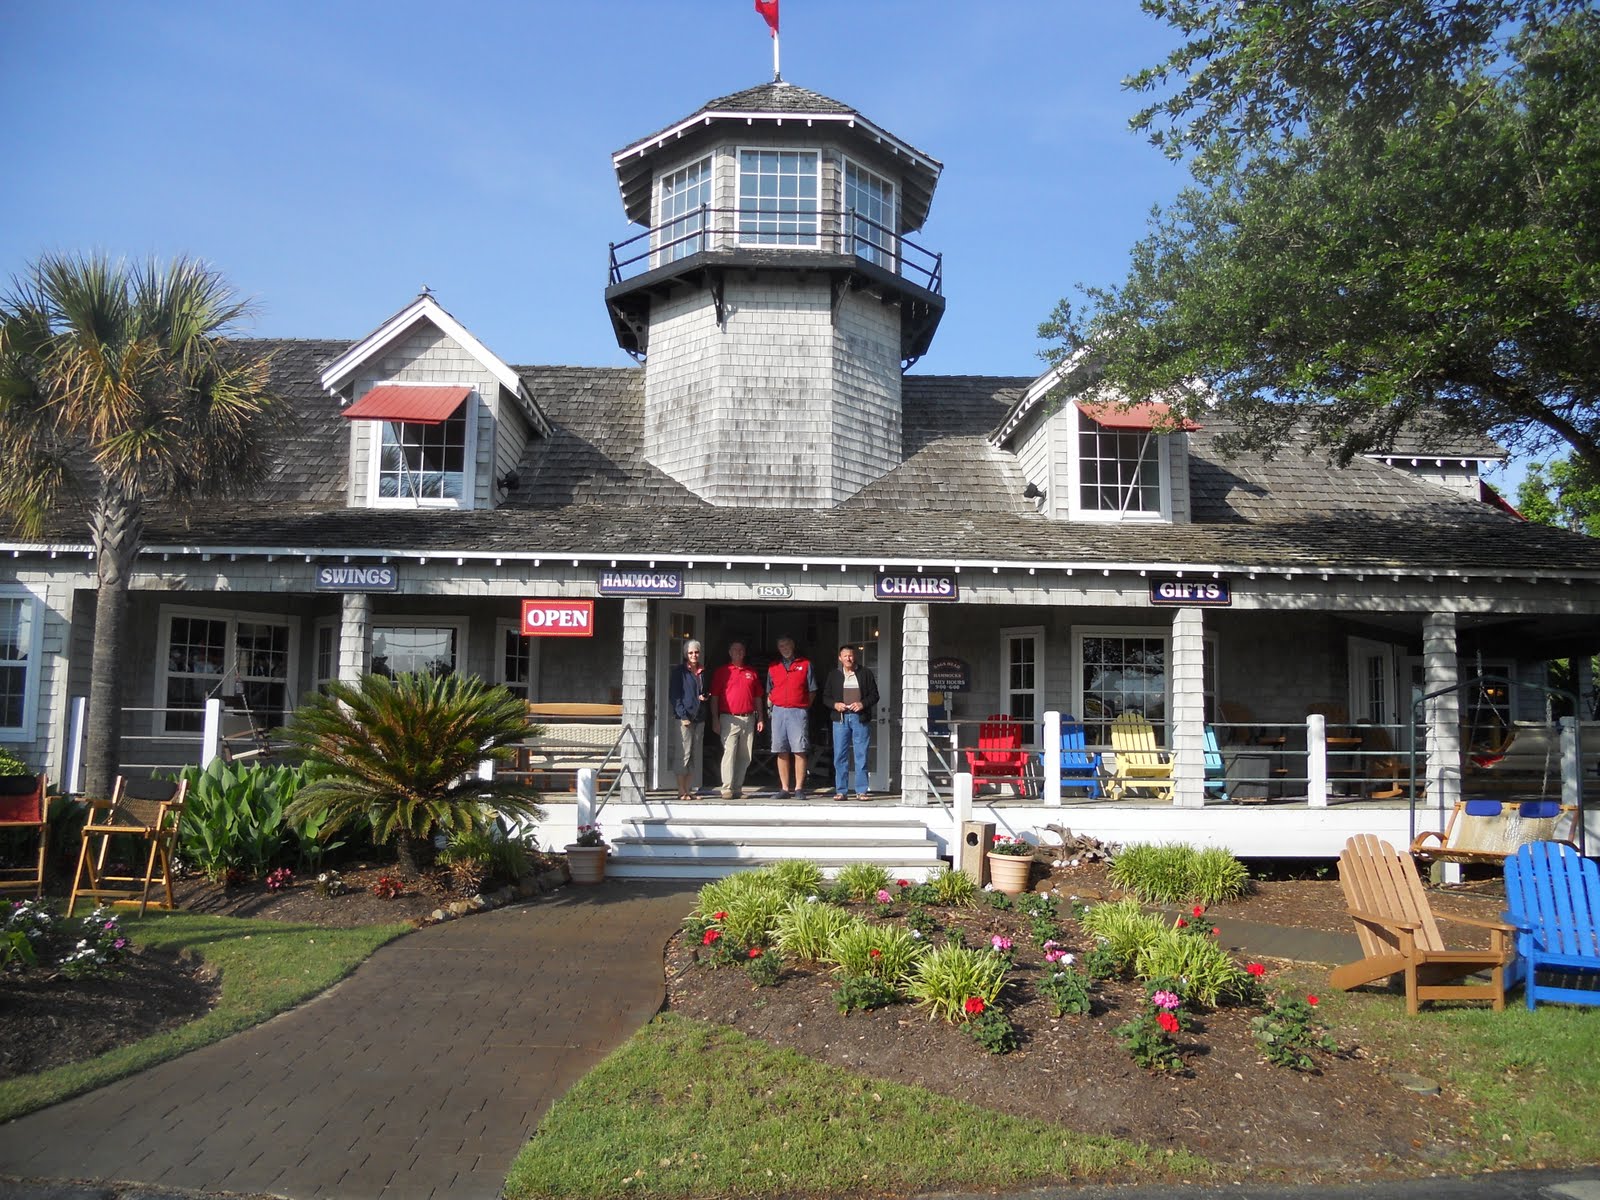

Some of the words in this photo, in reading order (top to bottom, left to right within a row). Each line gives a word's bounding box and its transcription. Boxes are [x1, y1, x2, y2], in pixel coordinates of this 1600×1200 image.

[320, 568, 391, 584] SWINGS
[602, 573, 677, 588] HAMMOCKS
[758, 586, 789, 597] 1801
[881, 577, 951, 594] CHAIRS
[1159, 582, 1220, 599] GIFTS
[527, 609, 588, 627] OPEN
